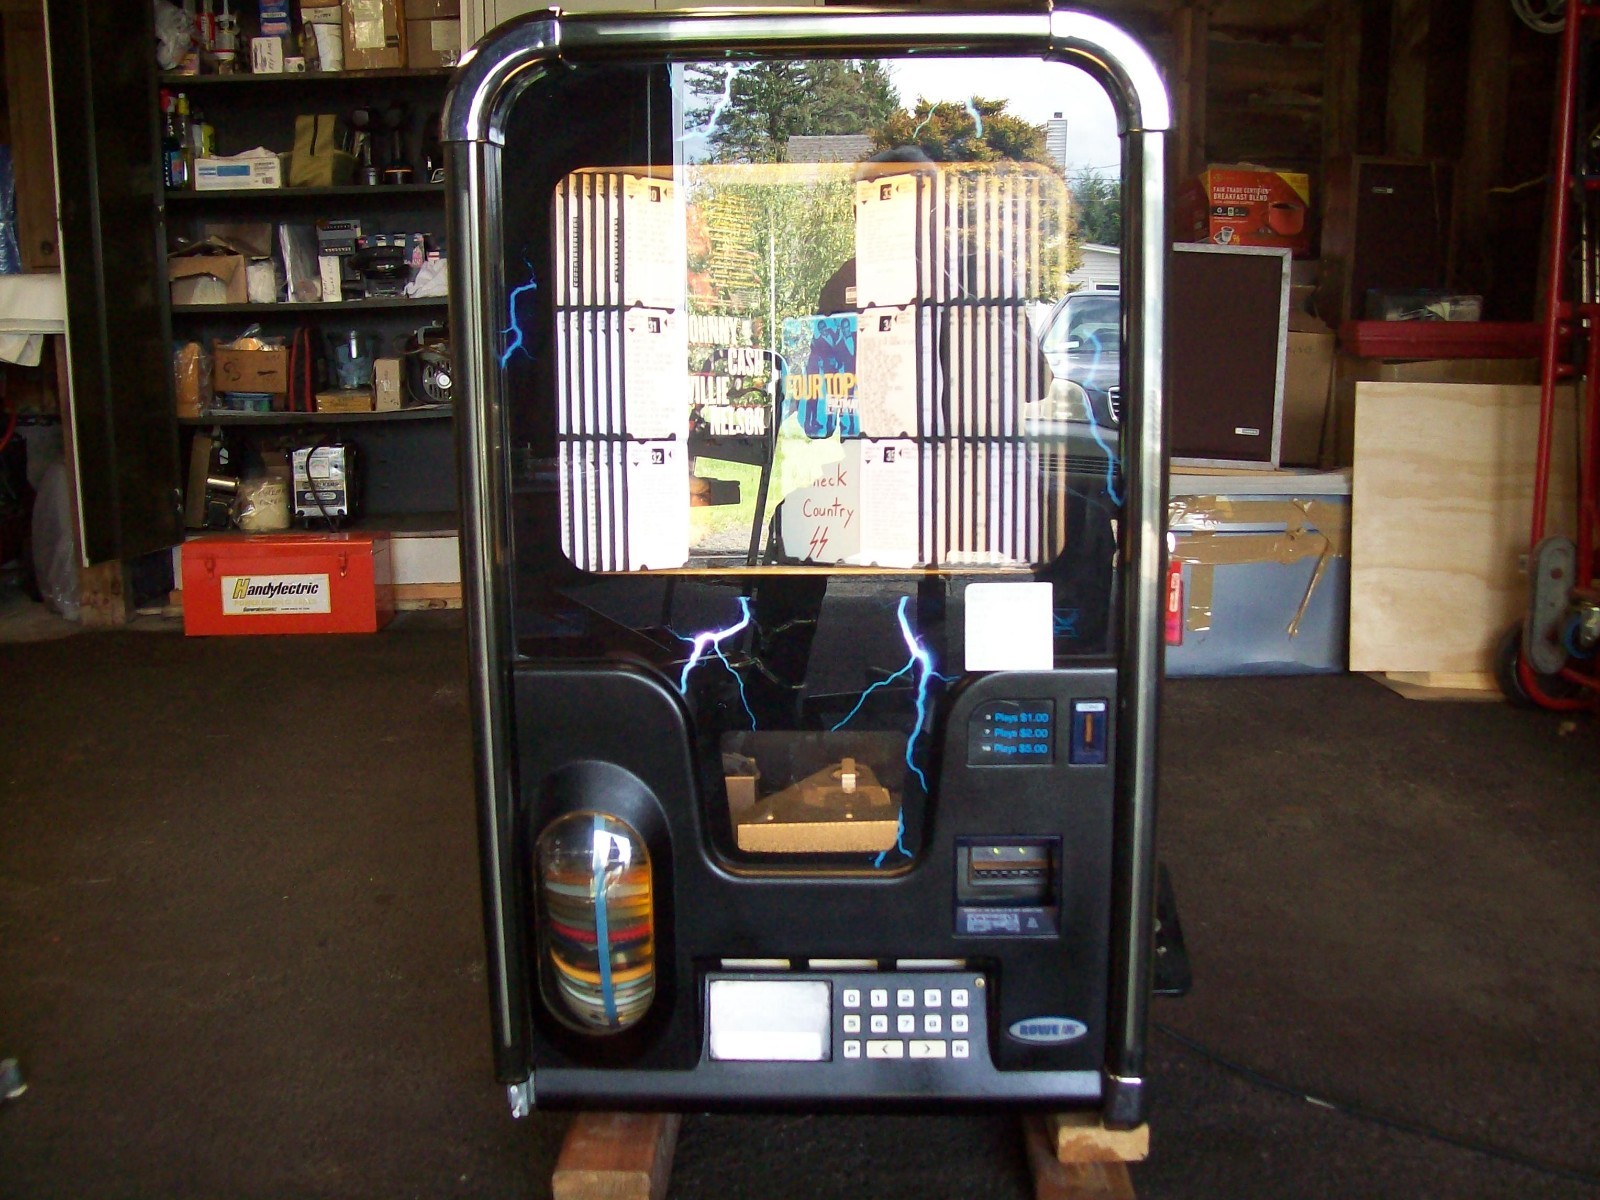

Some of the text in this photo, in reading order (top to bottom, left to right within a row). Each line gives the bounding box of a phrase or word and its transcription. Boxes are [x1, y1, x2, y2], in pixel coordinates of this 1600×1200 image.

[727, 346, 765, 377] CASH
[784, 373, 825, 401] FOUR
[708, 405, 766, 436] NELSON
[802, 496, 855, 529] Country
[231, 578, 319, 600] Handylectric
